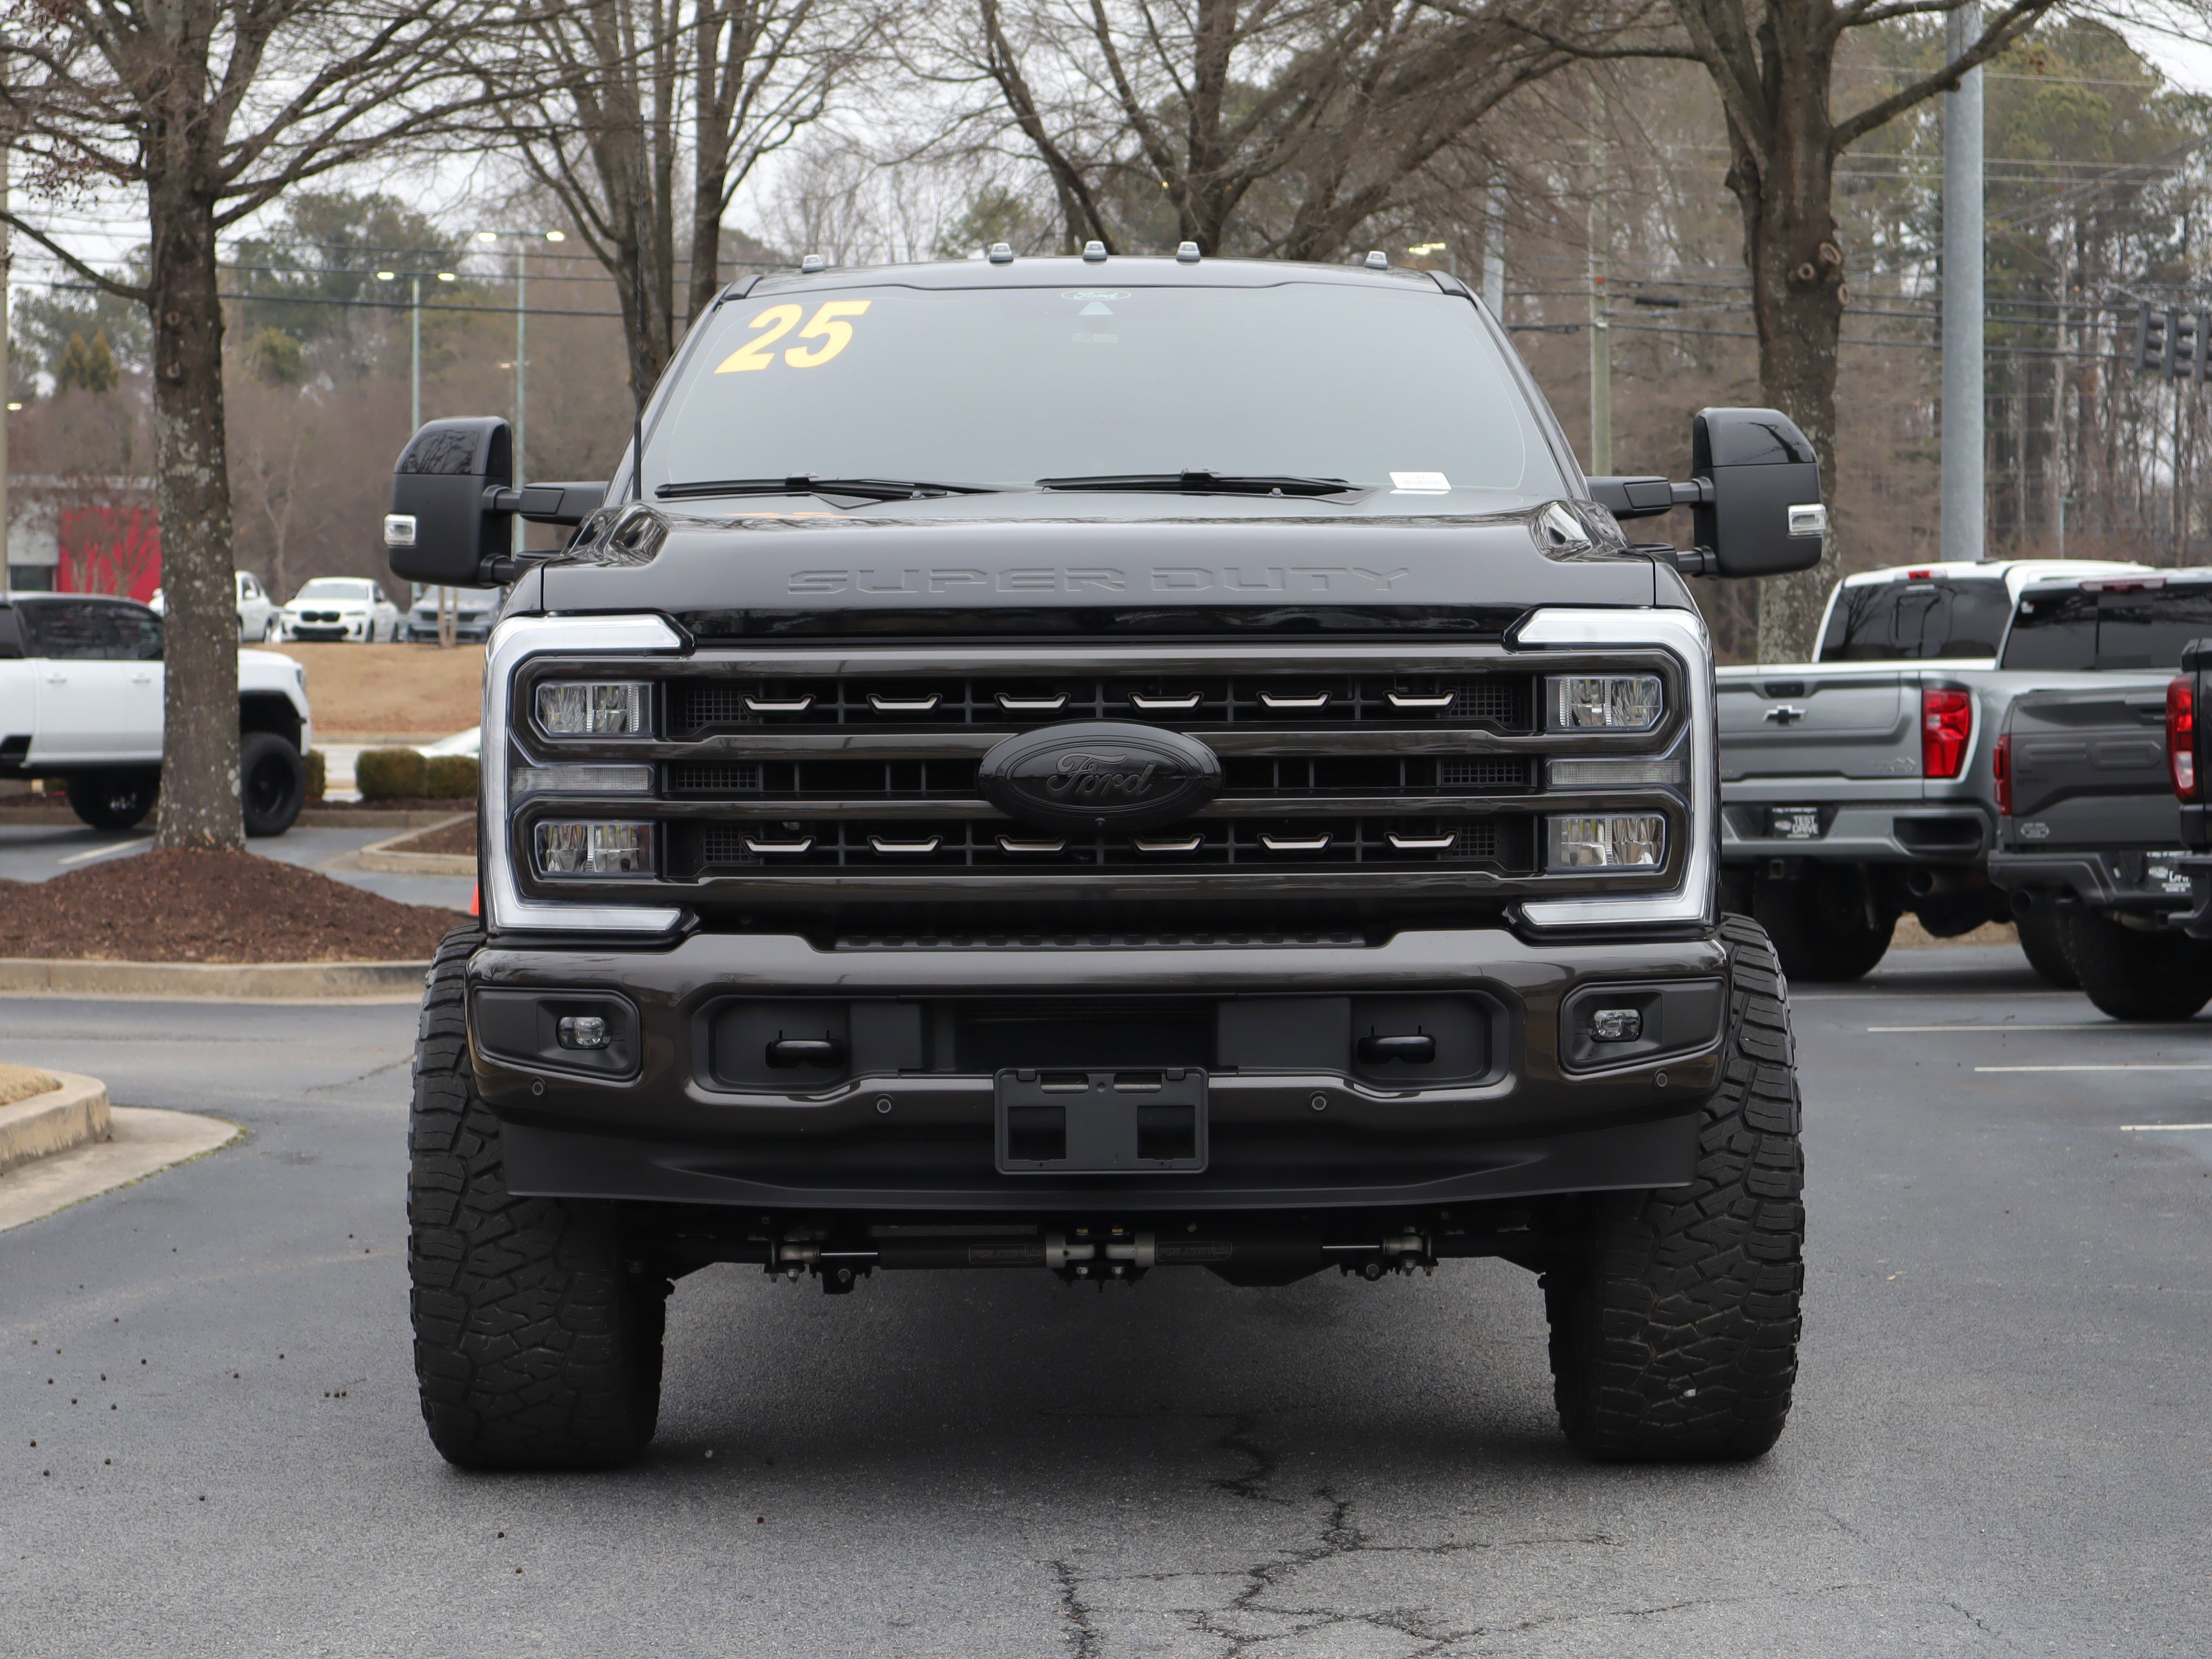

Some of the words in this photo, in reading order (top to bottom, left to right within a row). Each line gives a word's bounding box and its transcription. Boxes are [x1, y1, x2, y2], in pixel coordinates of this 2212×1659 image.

[1073, 290, 1119, 299] Ford
[714, 300, 872, 374] 25
[788, 568, 1125, 594] SUPER
[1151, 567, 1409, 591] DUTY
[1046, 753, 1155, 796] Ford
[1793, 815, 1815, 825] TEST
[1792, 824, 1818, 834] DRIVE
[1158, 1247, 1212, 1257] FALCON
